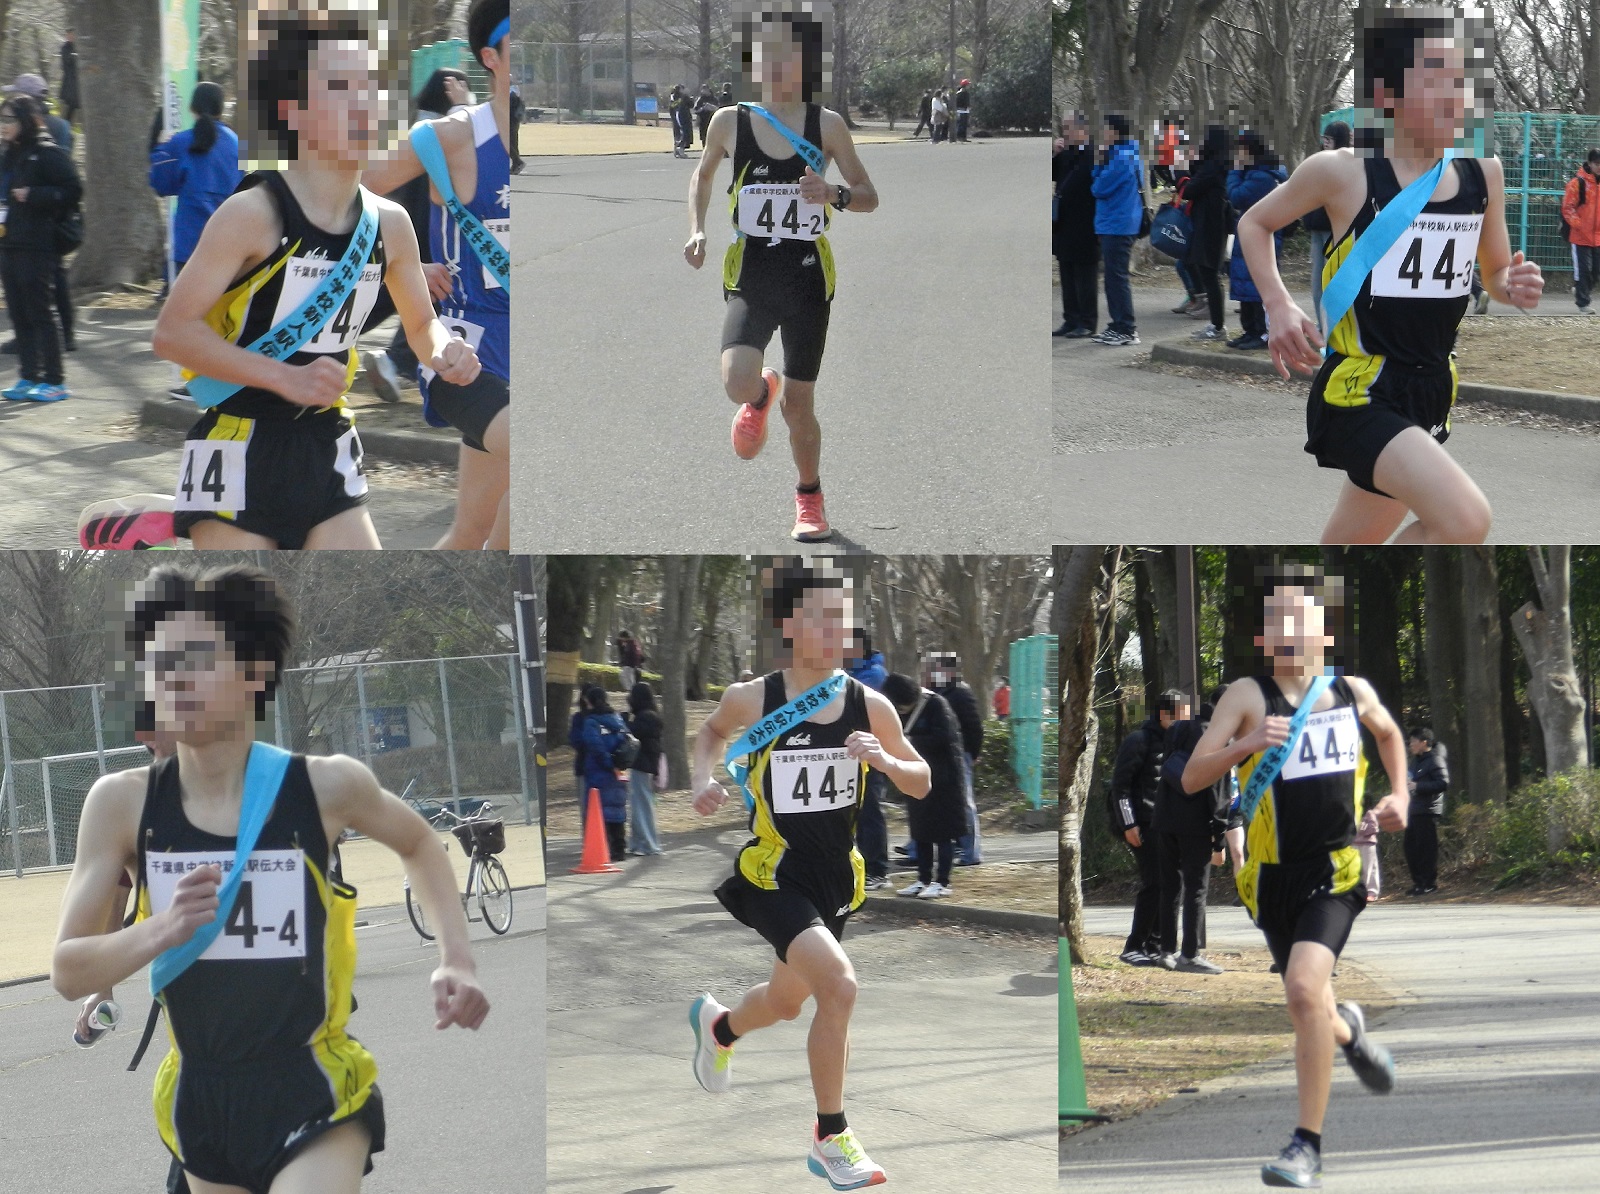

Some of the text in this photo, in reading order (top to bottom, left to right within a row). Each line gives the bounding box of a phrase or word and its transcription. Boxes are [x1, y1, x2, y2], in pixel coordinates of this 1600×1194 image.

[757, 199, 821, 235] 44-2
[1397, 238, 1472, 290] 44-3
[181, 449, 225, 502] 44
[1298, 727, 1356, 769] 44-6
[792, 765, 855, 807] 44-5
